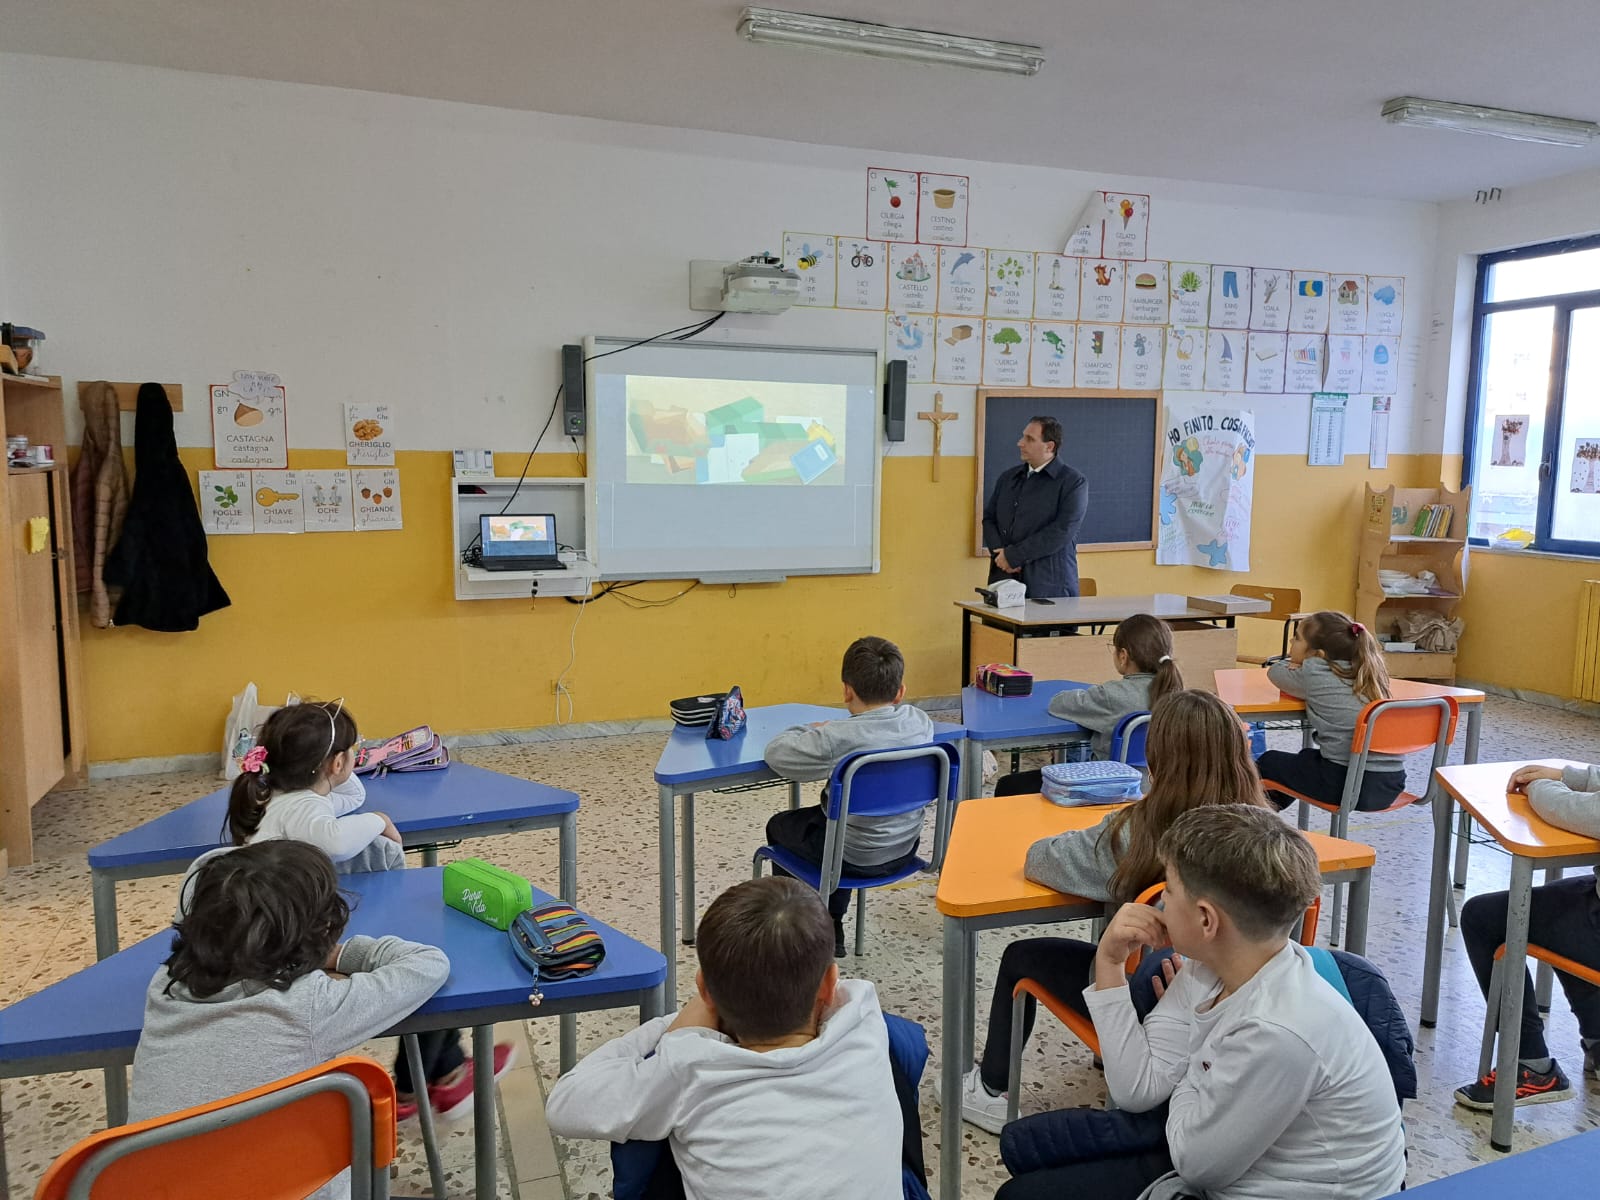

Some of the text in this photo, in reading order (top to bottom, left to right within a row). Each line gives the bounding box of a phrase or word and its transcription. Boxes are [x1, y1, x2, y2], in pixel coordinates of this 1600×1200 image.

[1131, 296, 1163, 304] AMBURGER
[213, 389, 230, 398] GN
[216, 406, 229, 414] gn
[226, 434, 274, 443] CASTAGNA
[1168, 427, 1181, 446] HO
[348, 441, 392, 449] GHERIGLIO
[232, 445, 269, 454] castagna
[212, 509, 243, 517] FOGLIE
[263, 508, 294, 516] CHIAVE
[360, 505, 395, 513] GHIANDE
[462, 889, 483, 902] Pura
[468, 900, 487, 912] Vida
